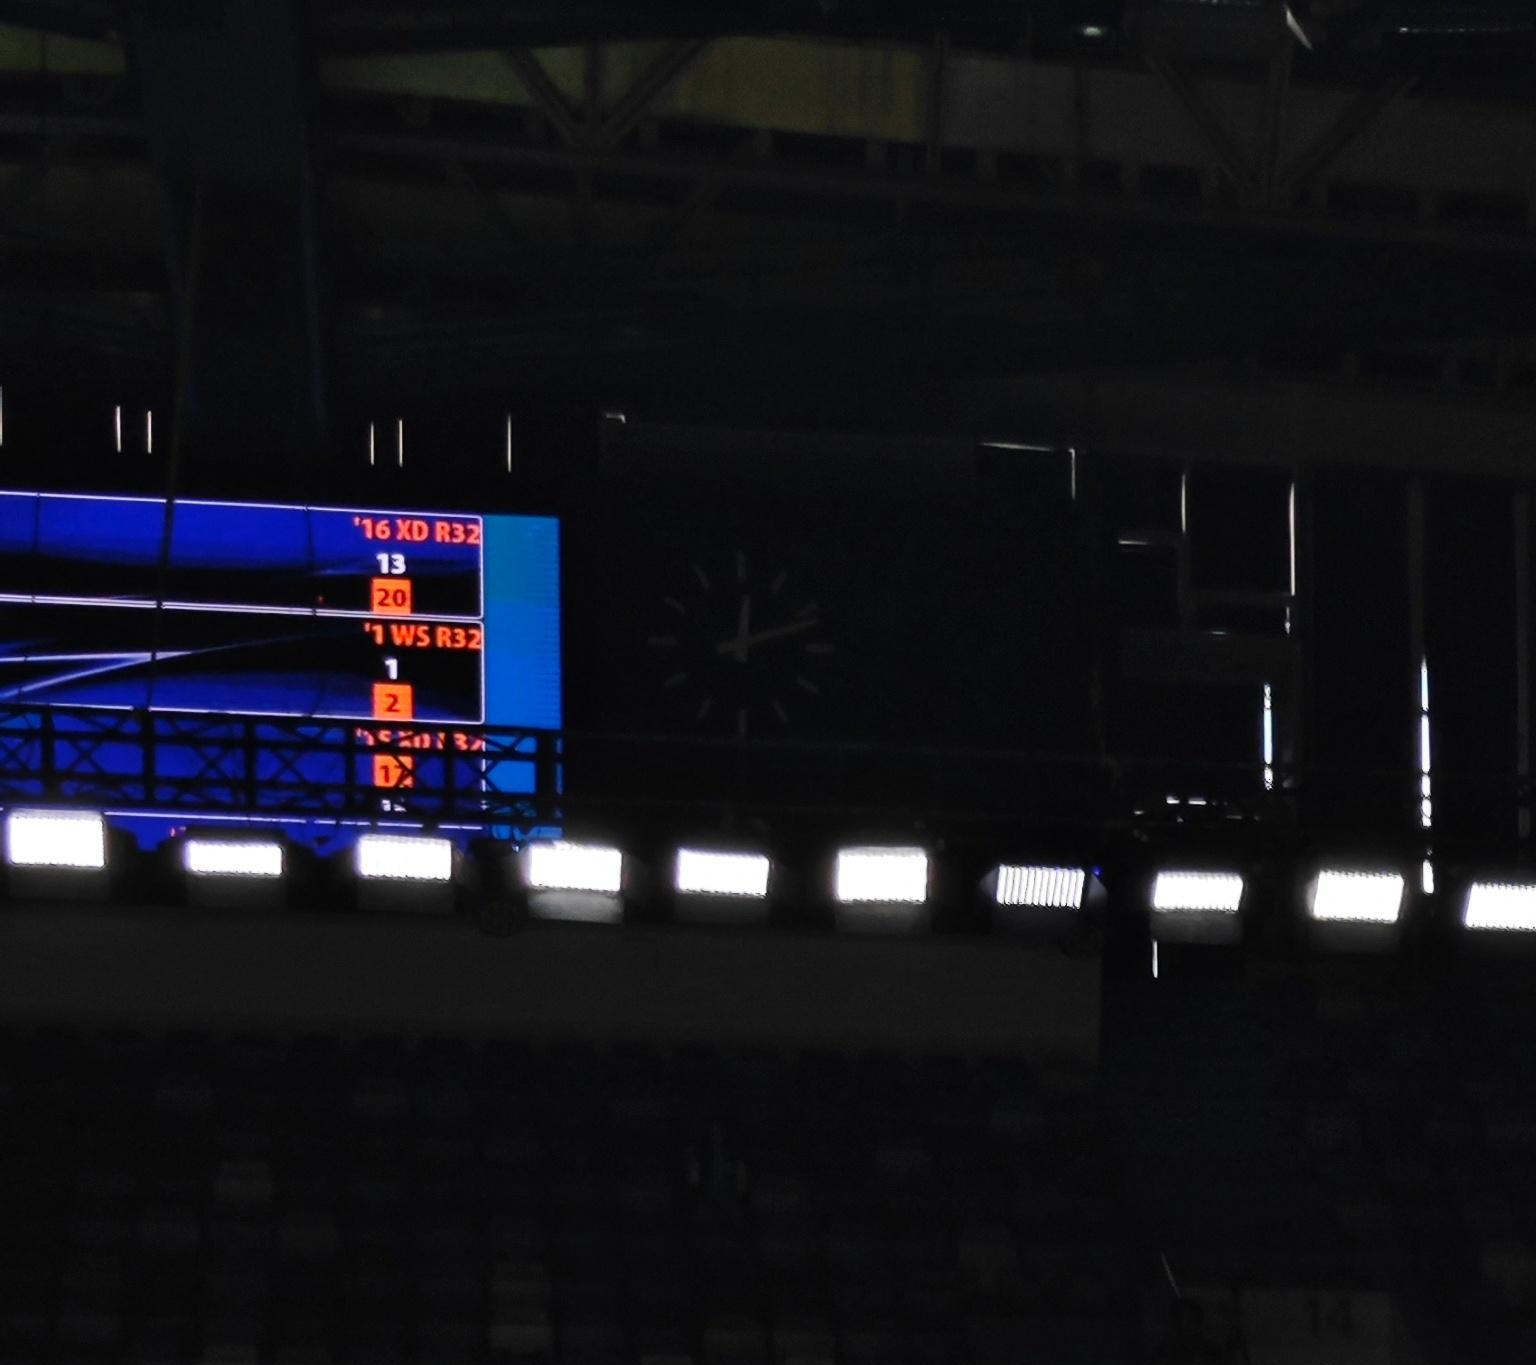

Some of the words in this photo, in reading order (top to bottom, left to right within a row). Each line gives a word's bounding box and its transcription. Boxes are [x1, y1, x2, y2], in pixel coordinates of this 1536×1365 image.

[397, 519, 429, 542] XD
[435, 521, 481, 545] R32
[376, 553, 407, 575] 13
[377, 588, 406, 607] 20
[390, 624, 431, 648] WS
[435, 627, 481, 650] R32
[384, 657, 399, 681] 1
[385, 694, 399, 713] 2
